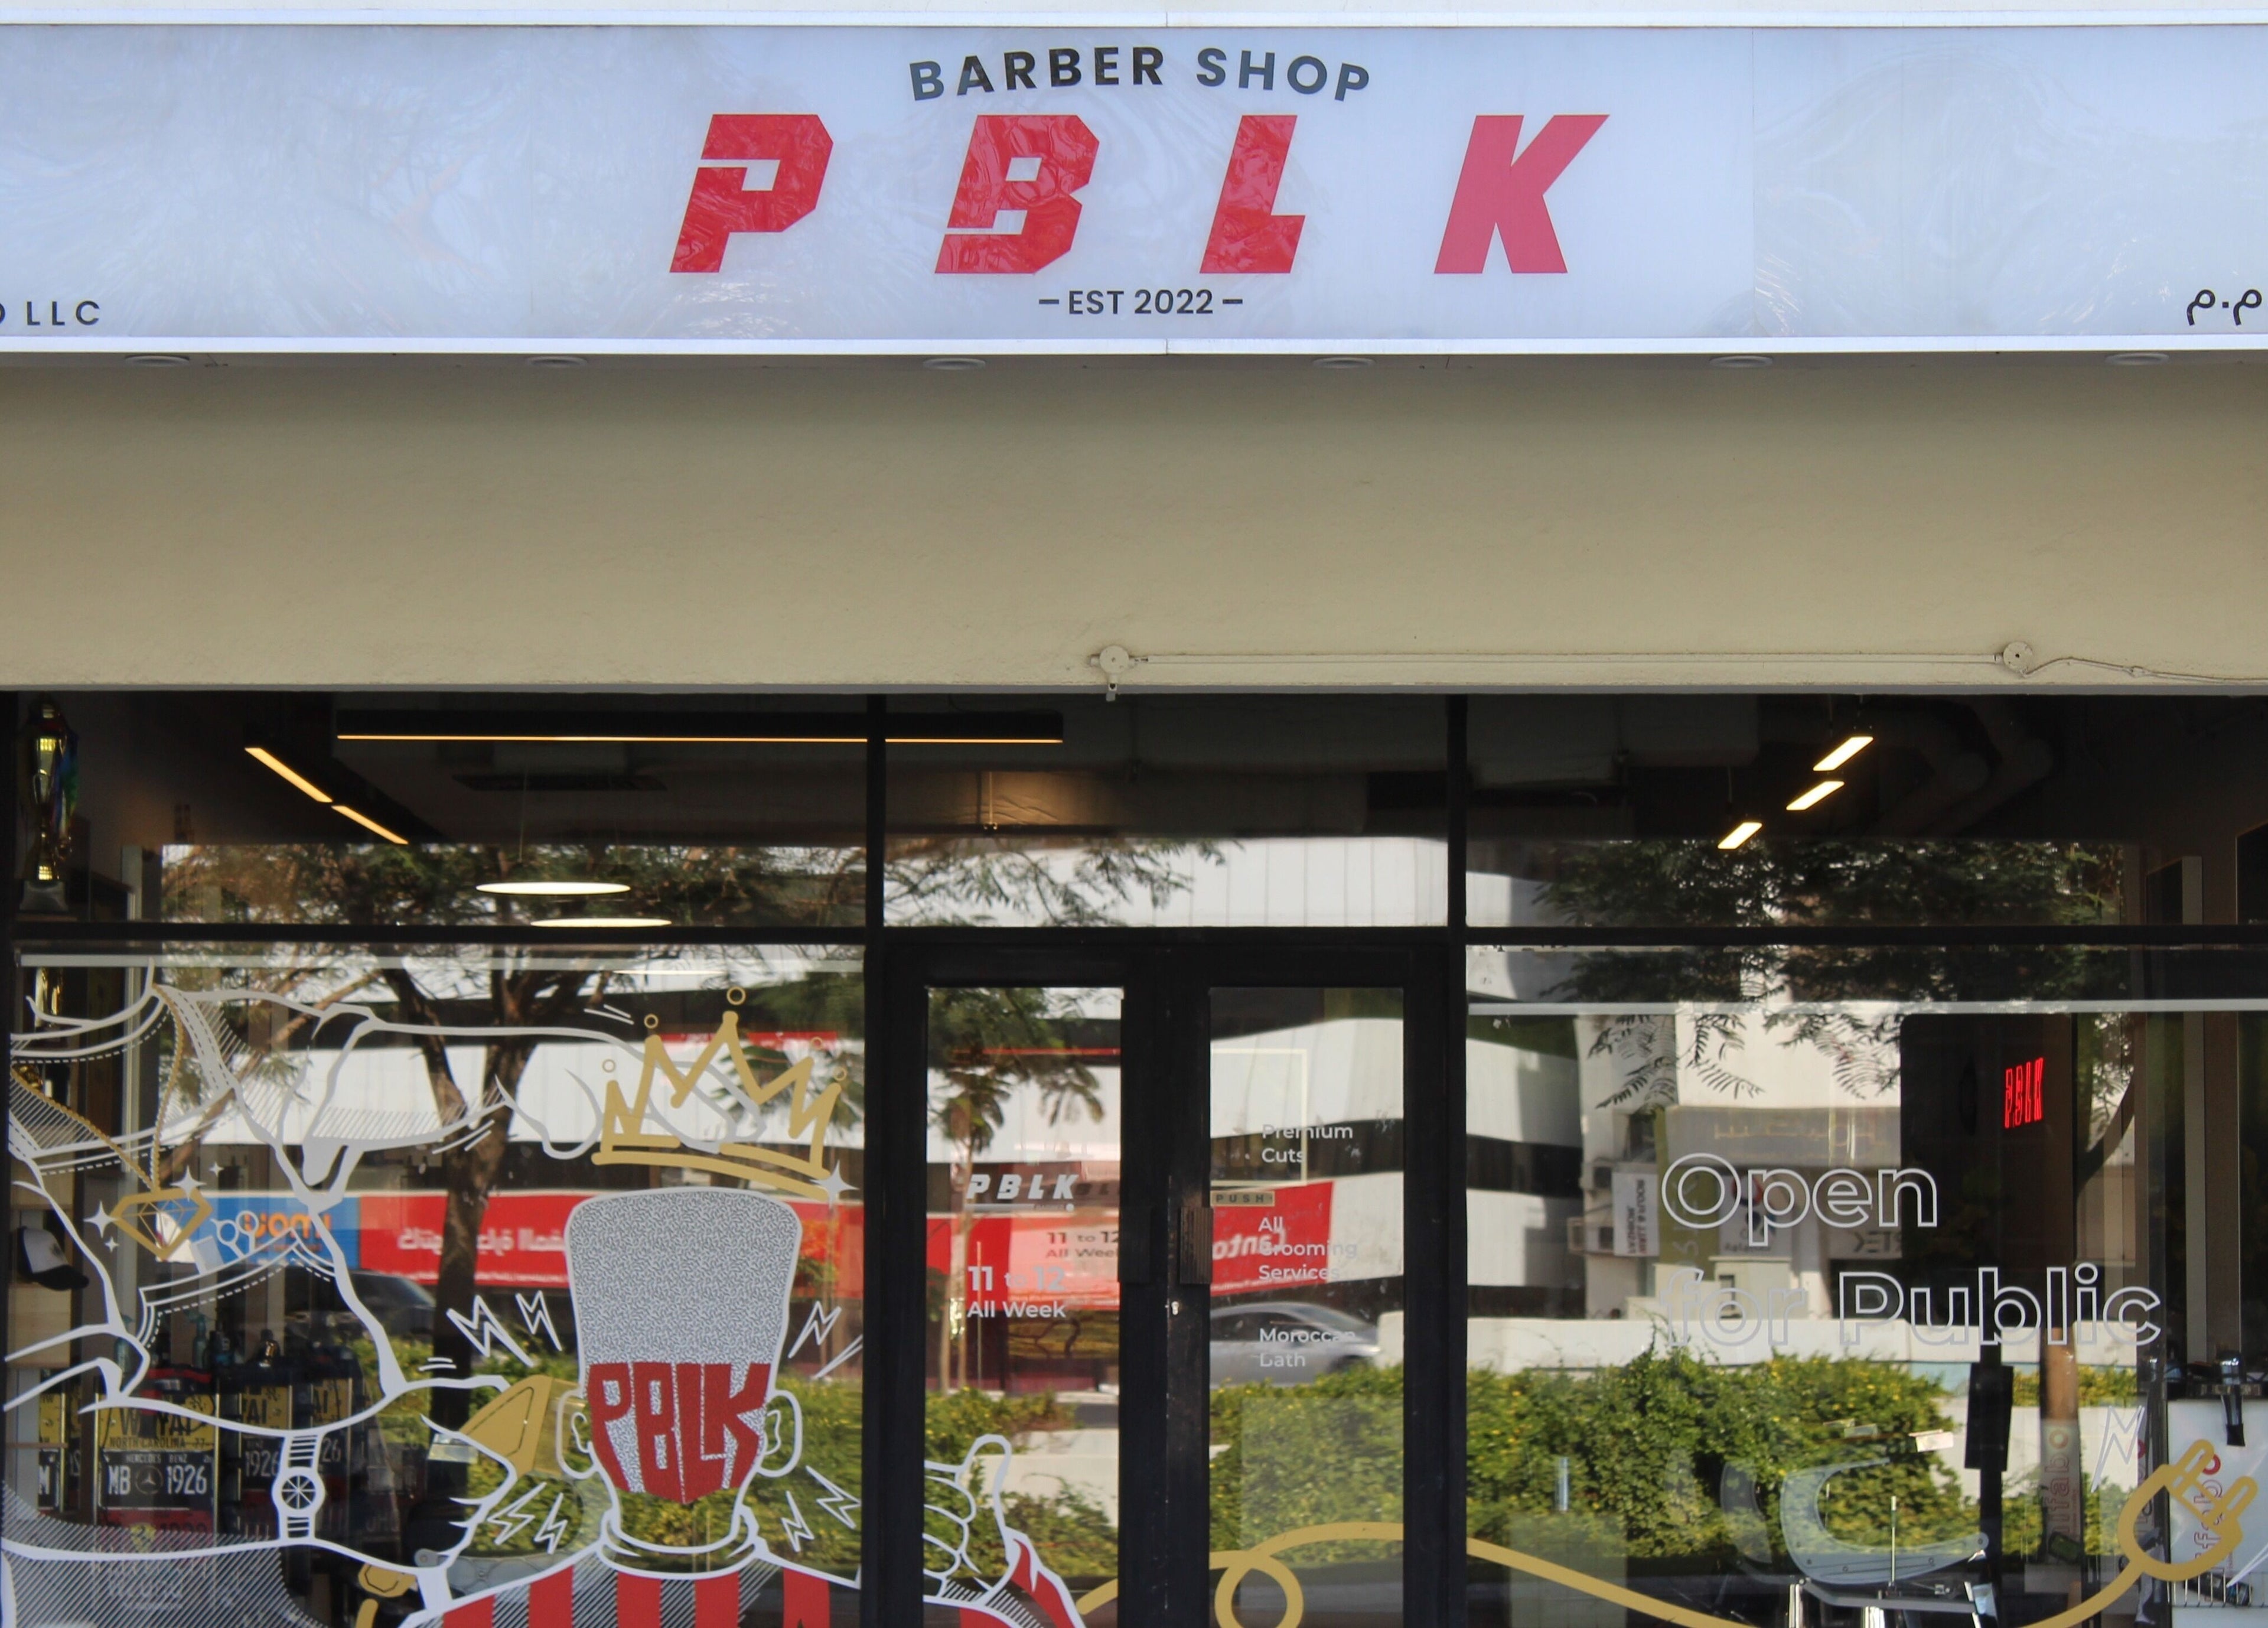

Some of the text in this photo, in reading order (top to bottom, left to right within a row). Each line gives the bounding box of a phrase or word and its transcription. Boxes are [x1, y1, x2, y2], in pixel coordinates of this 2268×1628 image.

[910, 47, 1370, 102] BARBER SHOP
[671, 115, 1608, 274] PBLK
[27, 301, 100, 326] LLC
[1068, 290, 1213, 315] EST 2022
[1262, 1124, 1353, 1140] Premium
[1262, 1147, 1305, 1164] Cuts
[965, 1174, 1079, 1199] PBLK
[1216, 1194, 1264, 1203] PUSH
[1662, 1153, 1938, 1246] Open
[1259, 1216, 1283, 1232] All
[967, 1266, 1066, 1291] 11 to 12
[1259, 1264, 1340, 1281] Services
[967, 1301, 995, 1318] All
[1002, 1301, 1065, 1318] Week
[1660, 1263, 2162, 1347] for Public
[587, 1362, 771, 1504] PBLK
[108, 1464, 207, 1495] MB 1926
